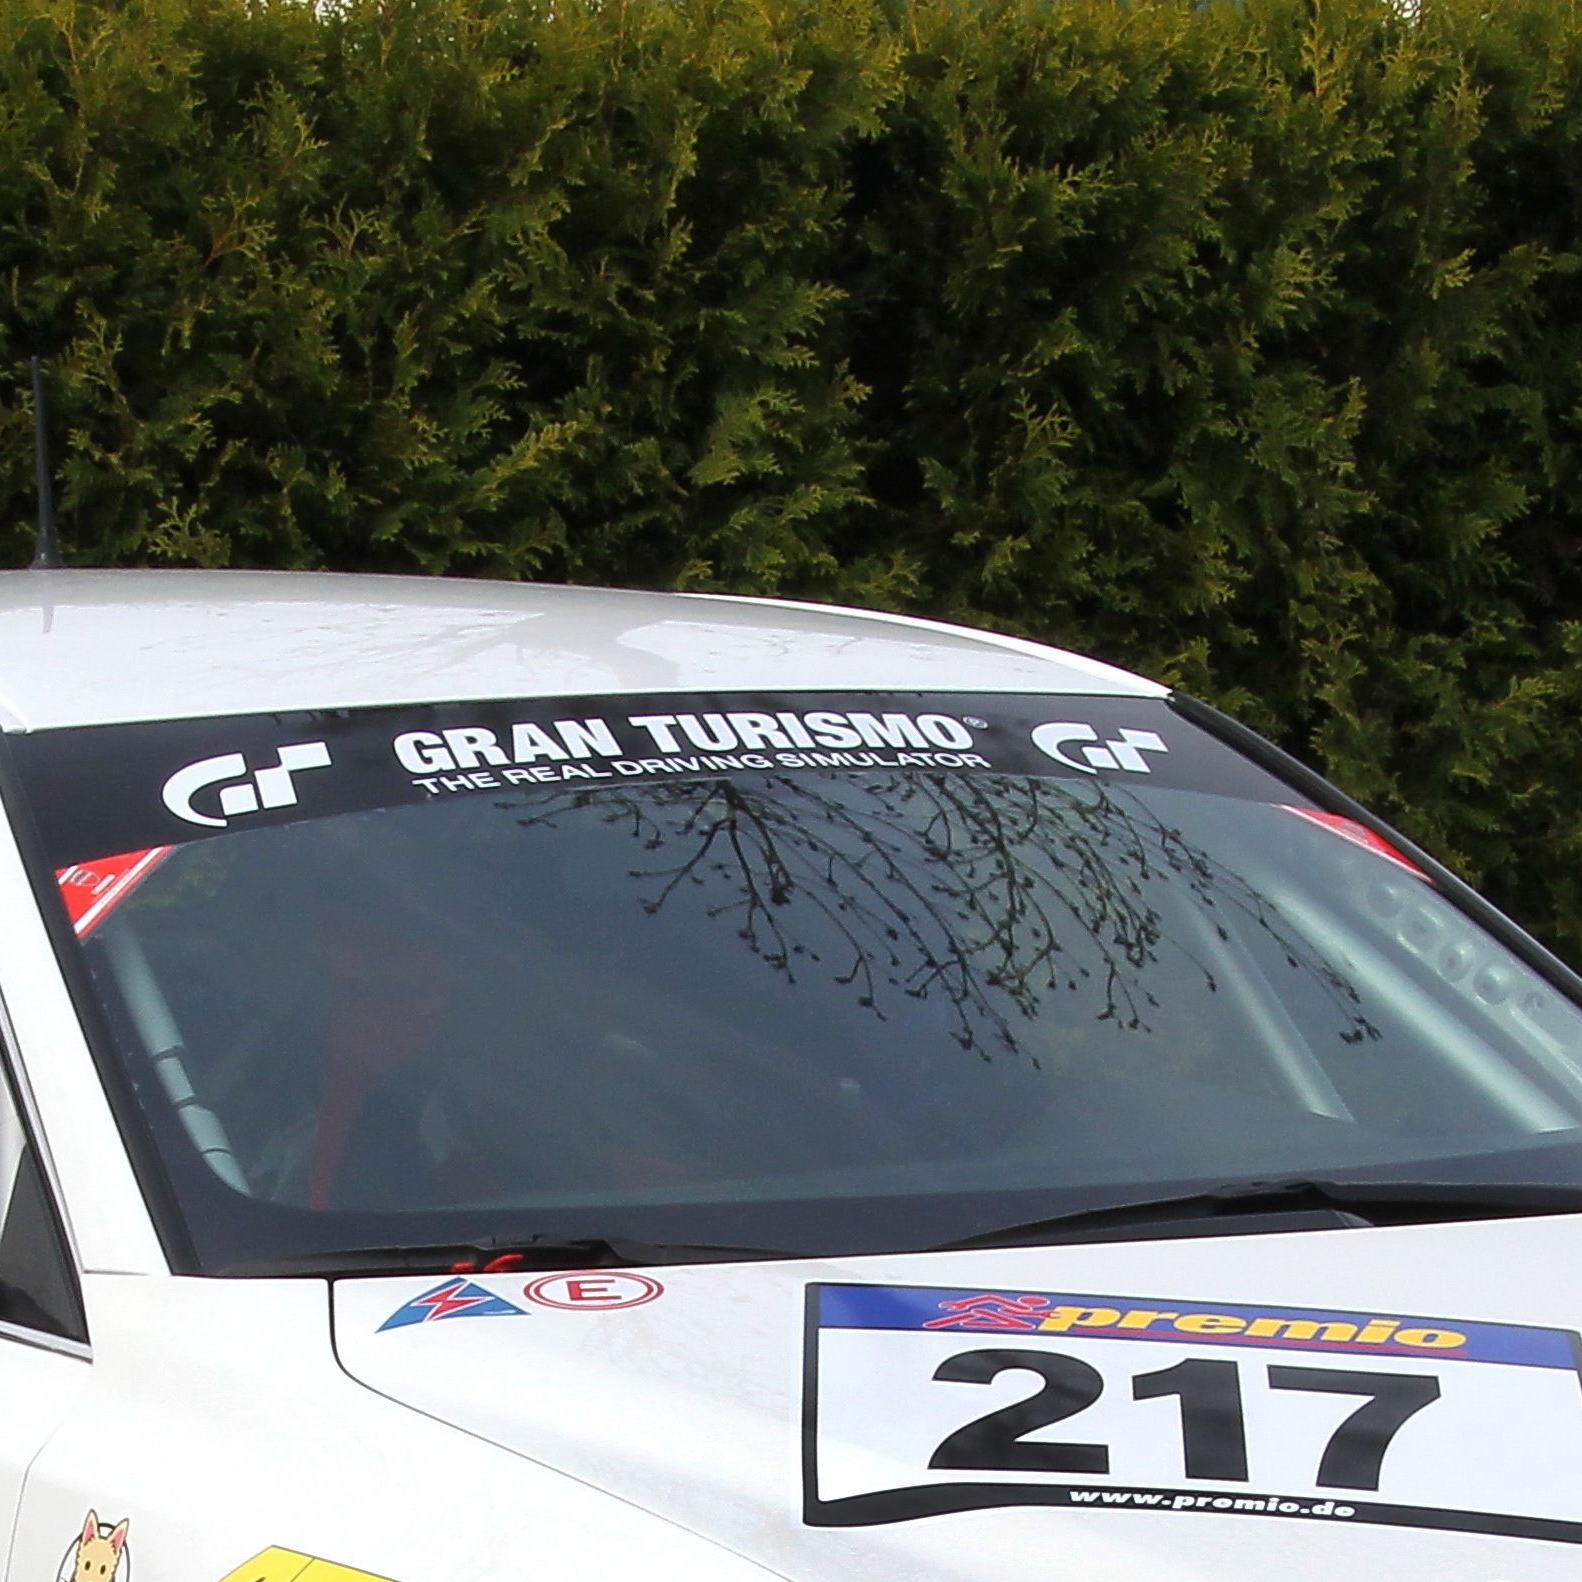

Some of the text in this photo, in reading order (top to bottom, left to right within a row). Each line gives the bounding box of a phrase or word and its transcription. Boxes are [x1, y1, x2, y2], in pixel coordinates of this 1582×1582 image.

[393, 711, 974, 775] GRAN TURISMO
[411, 752, 993, 795] THE REAL DRIVING SIMULATOR
[565, 1279, 623, 1301] E
[1036, 1303, 1468, 1350] premio
[927, 1348, 1442, 1492] 217
[1068, 1487, 1357, 1518] www.premio.de
